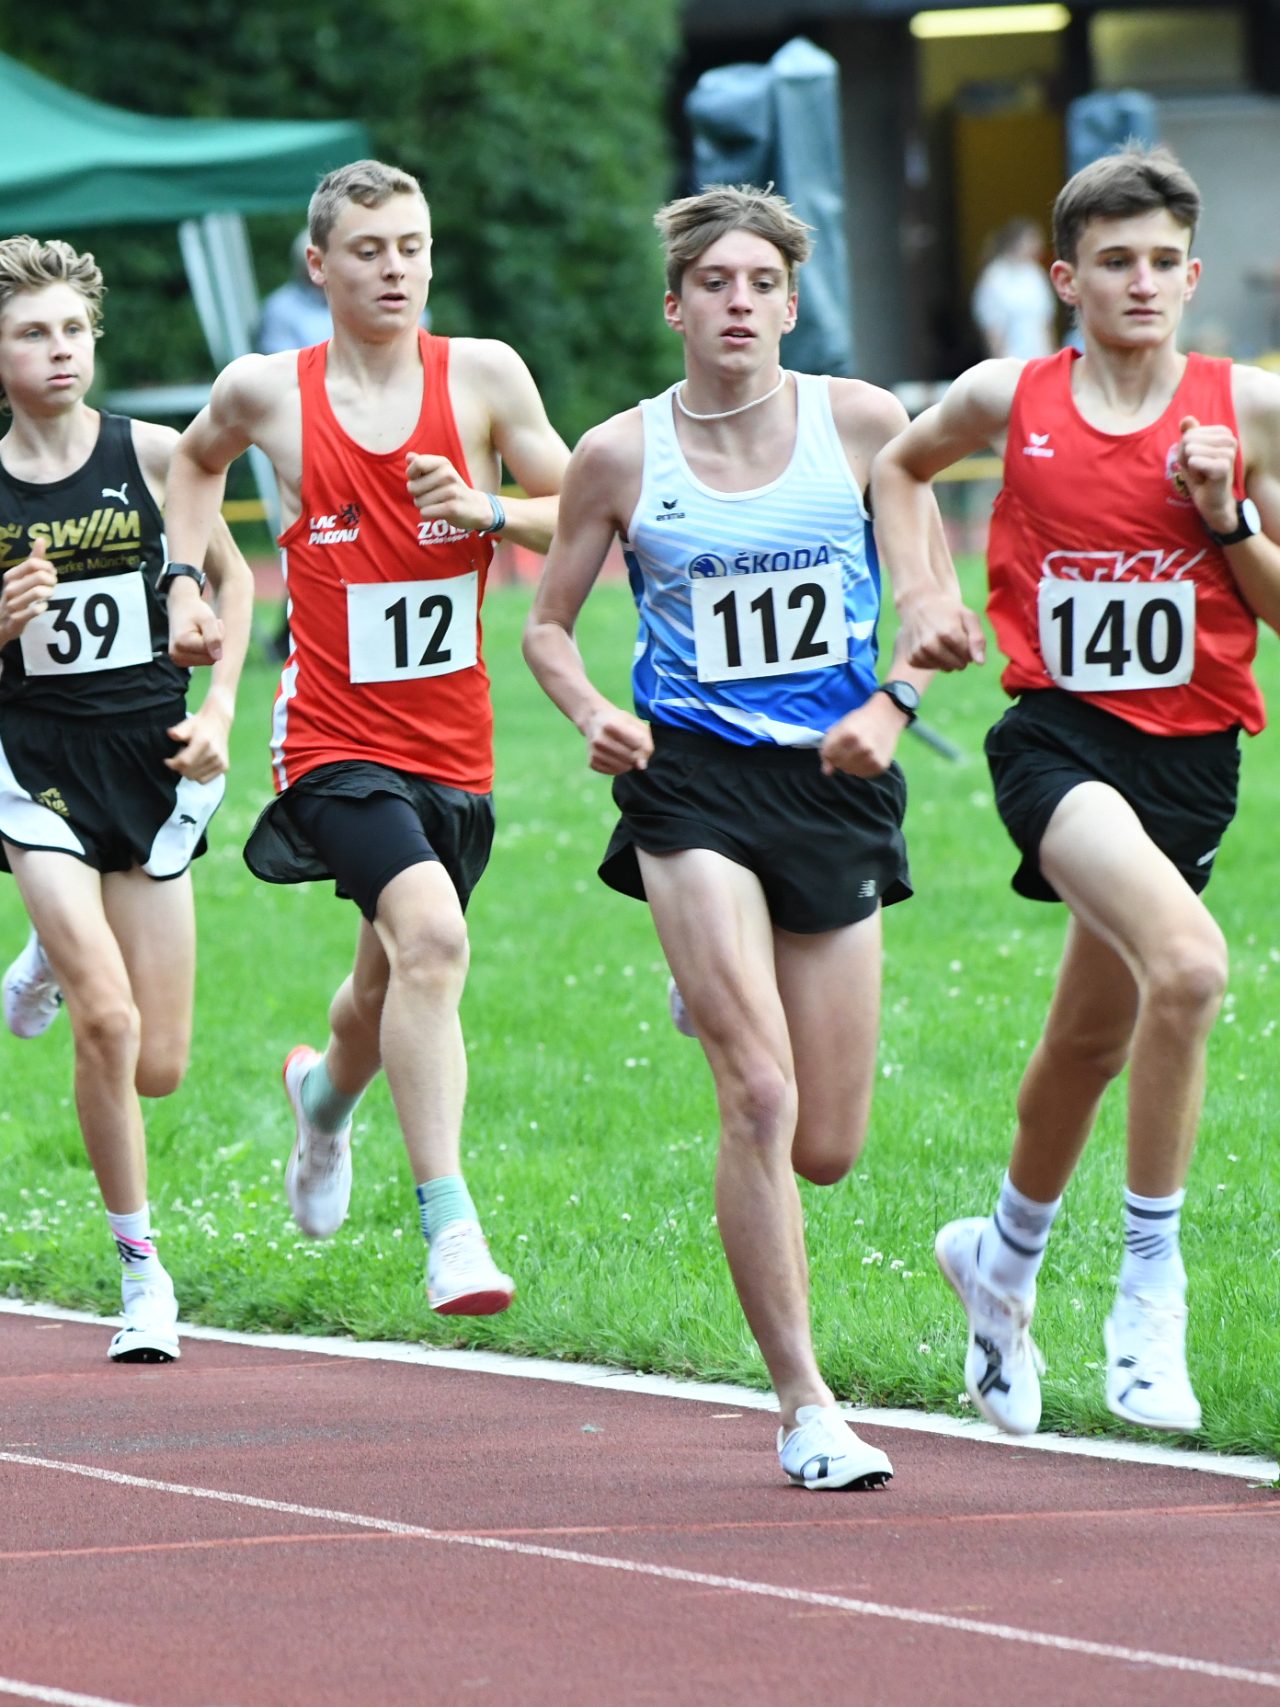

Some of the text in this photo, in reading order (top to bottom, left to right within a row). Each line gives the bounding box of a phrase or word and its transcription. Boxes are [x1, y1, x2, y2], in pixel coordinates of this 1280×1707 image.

[308, 528, 359, 545] PASSAU
[309, 515, 337, 529] LAC
[46, 592, 120, 665] 39
[384, 594, 454, 669] 12
[713, 582, 829, 668] 112
[1051, 597, 1184, 678] 140
